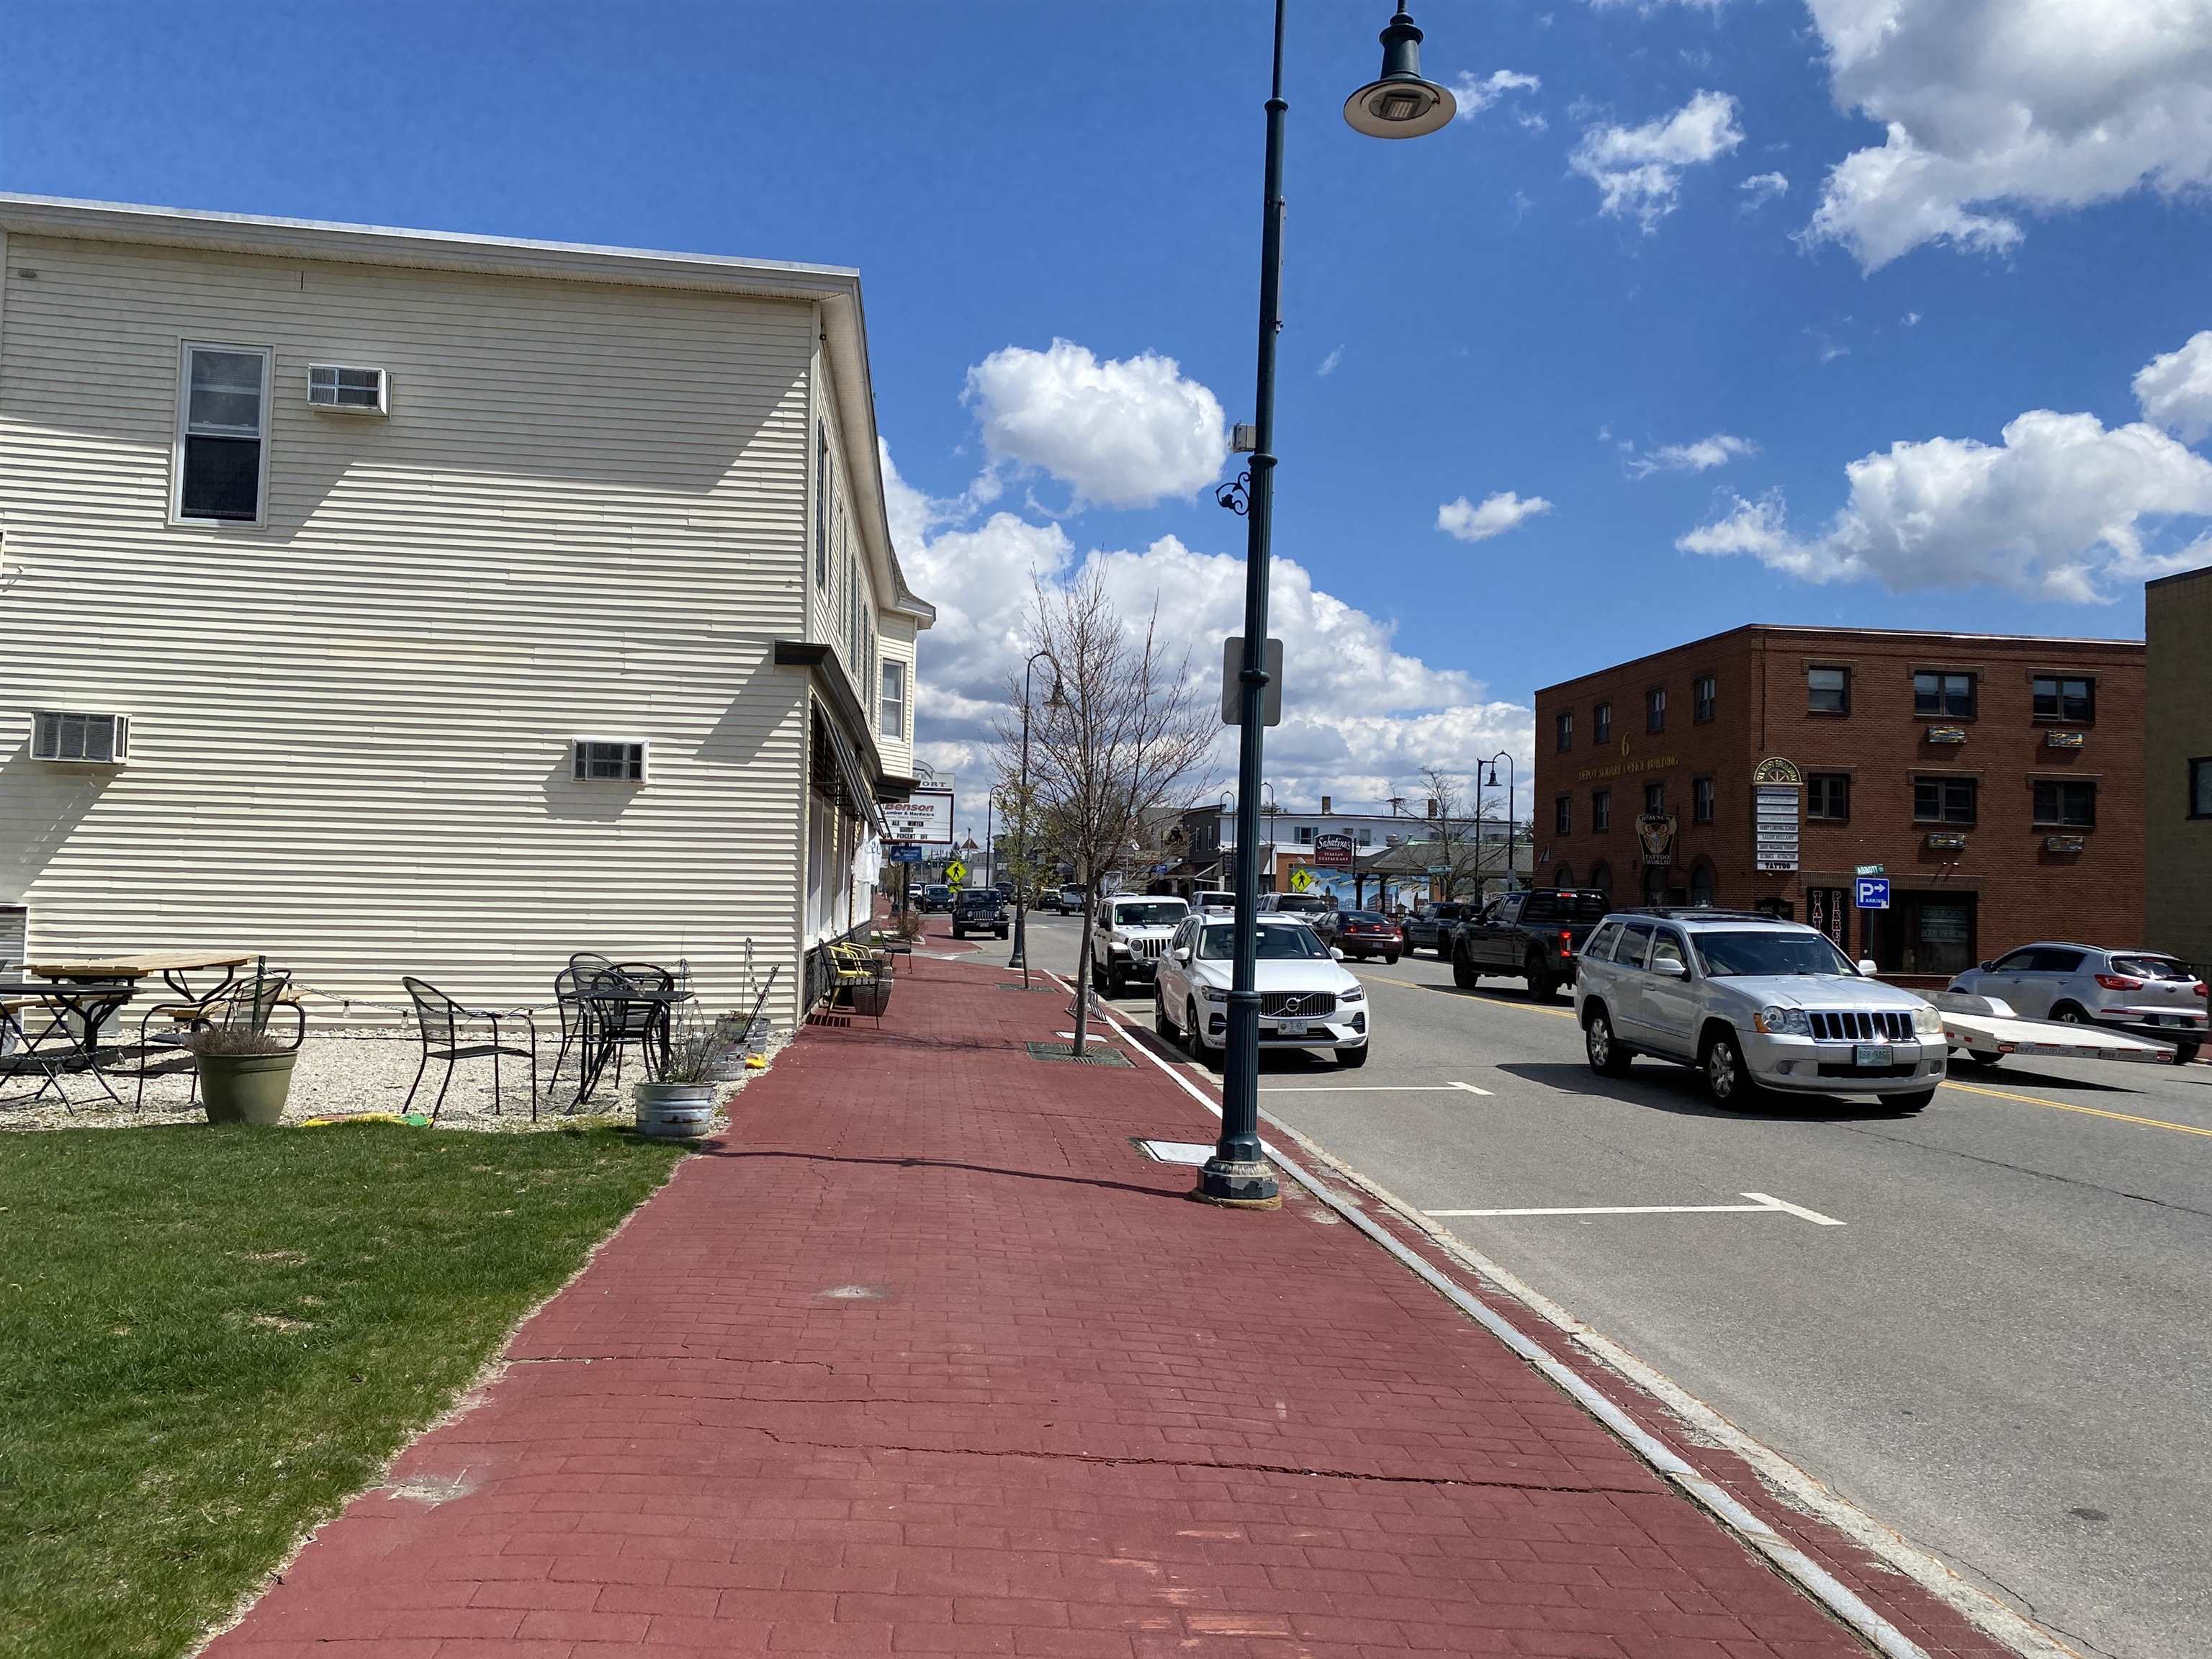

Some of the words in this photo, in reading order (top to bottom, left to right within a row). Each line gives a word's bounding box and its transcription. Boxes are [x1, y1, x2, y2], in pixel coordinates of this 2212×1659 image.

[1622, 731, 1630, 757] 6
[1579, 769, 1597, 781] DEPOT
[1599, 764, 1622, 778] SQUARE
[1624, 760, 1645, 774] OFFICE
[1647, 755, 1679, 770] BUILDING
[1762, 761, 1775, 772] WEST
[1775, 760, 1799, 782] BROADWAY
[1857, 866, 1879, 875] ABBOTT
[1812, 890, 1823, 932] TAT
